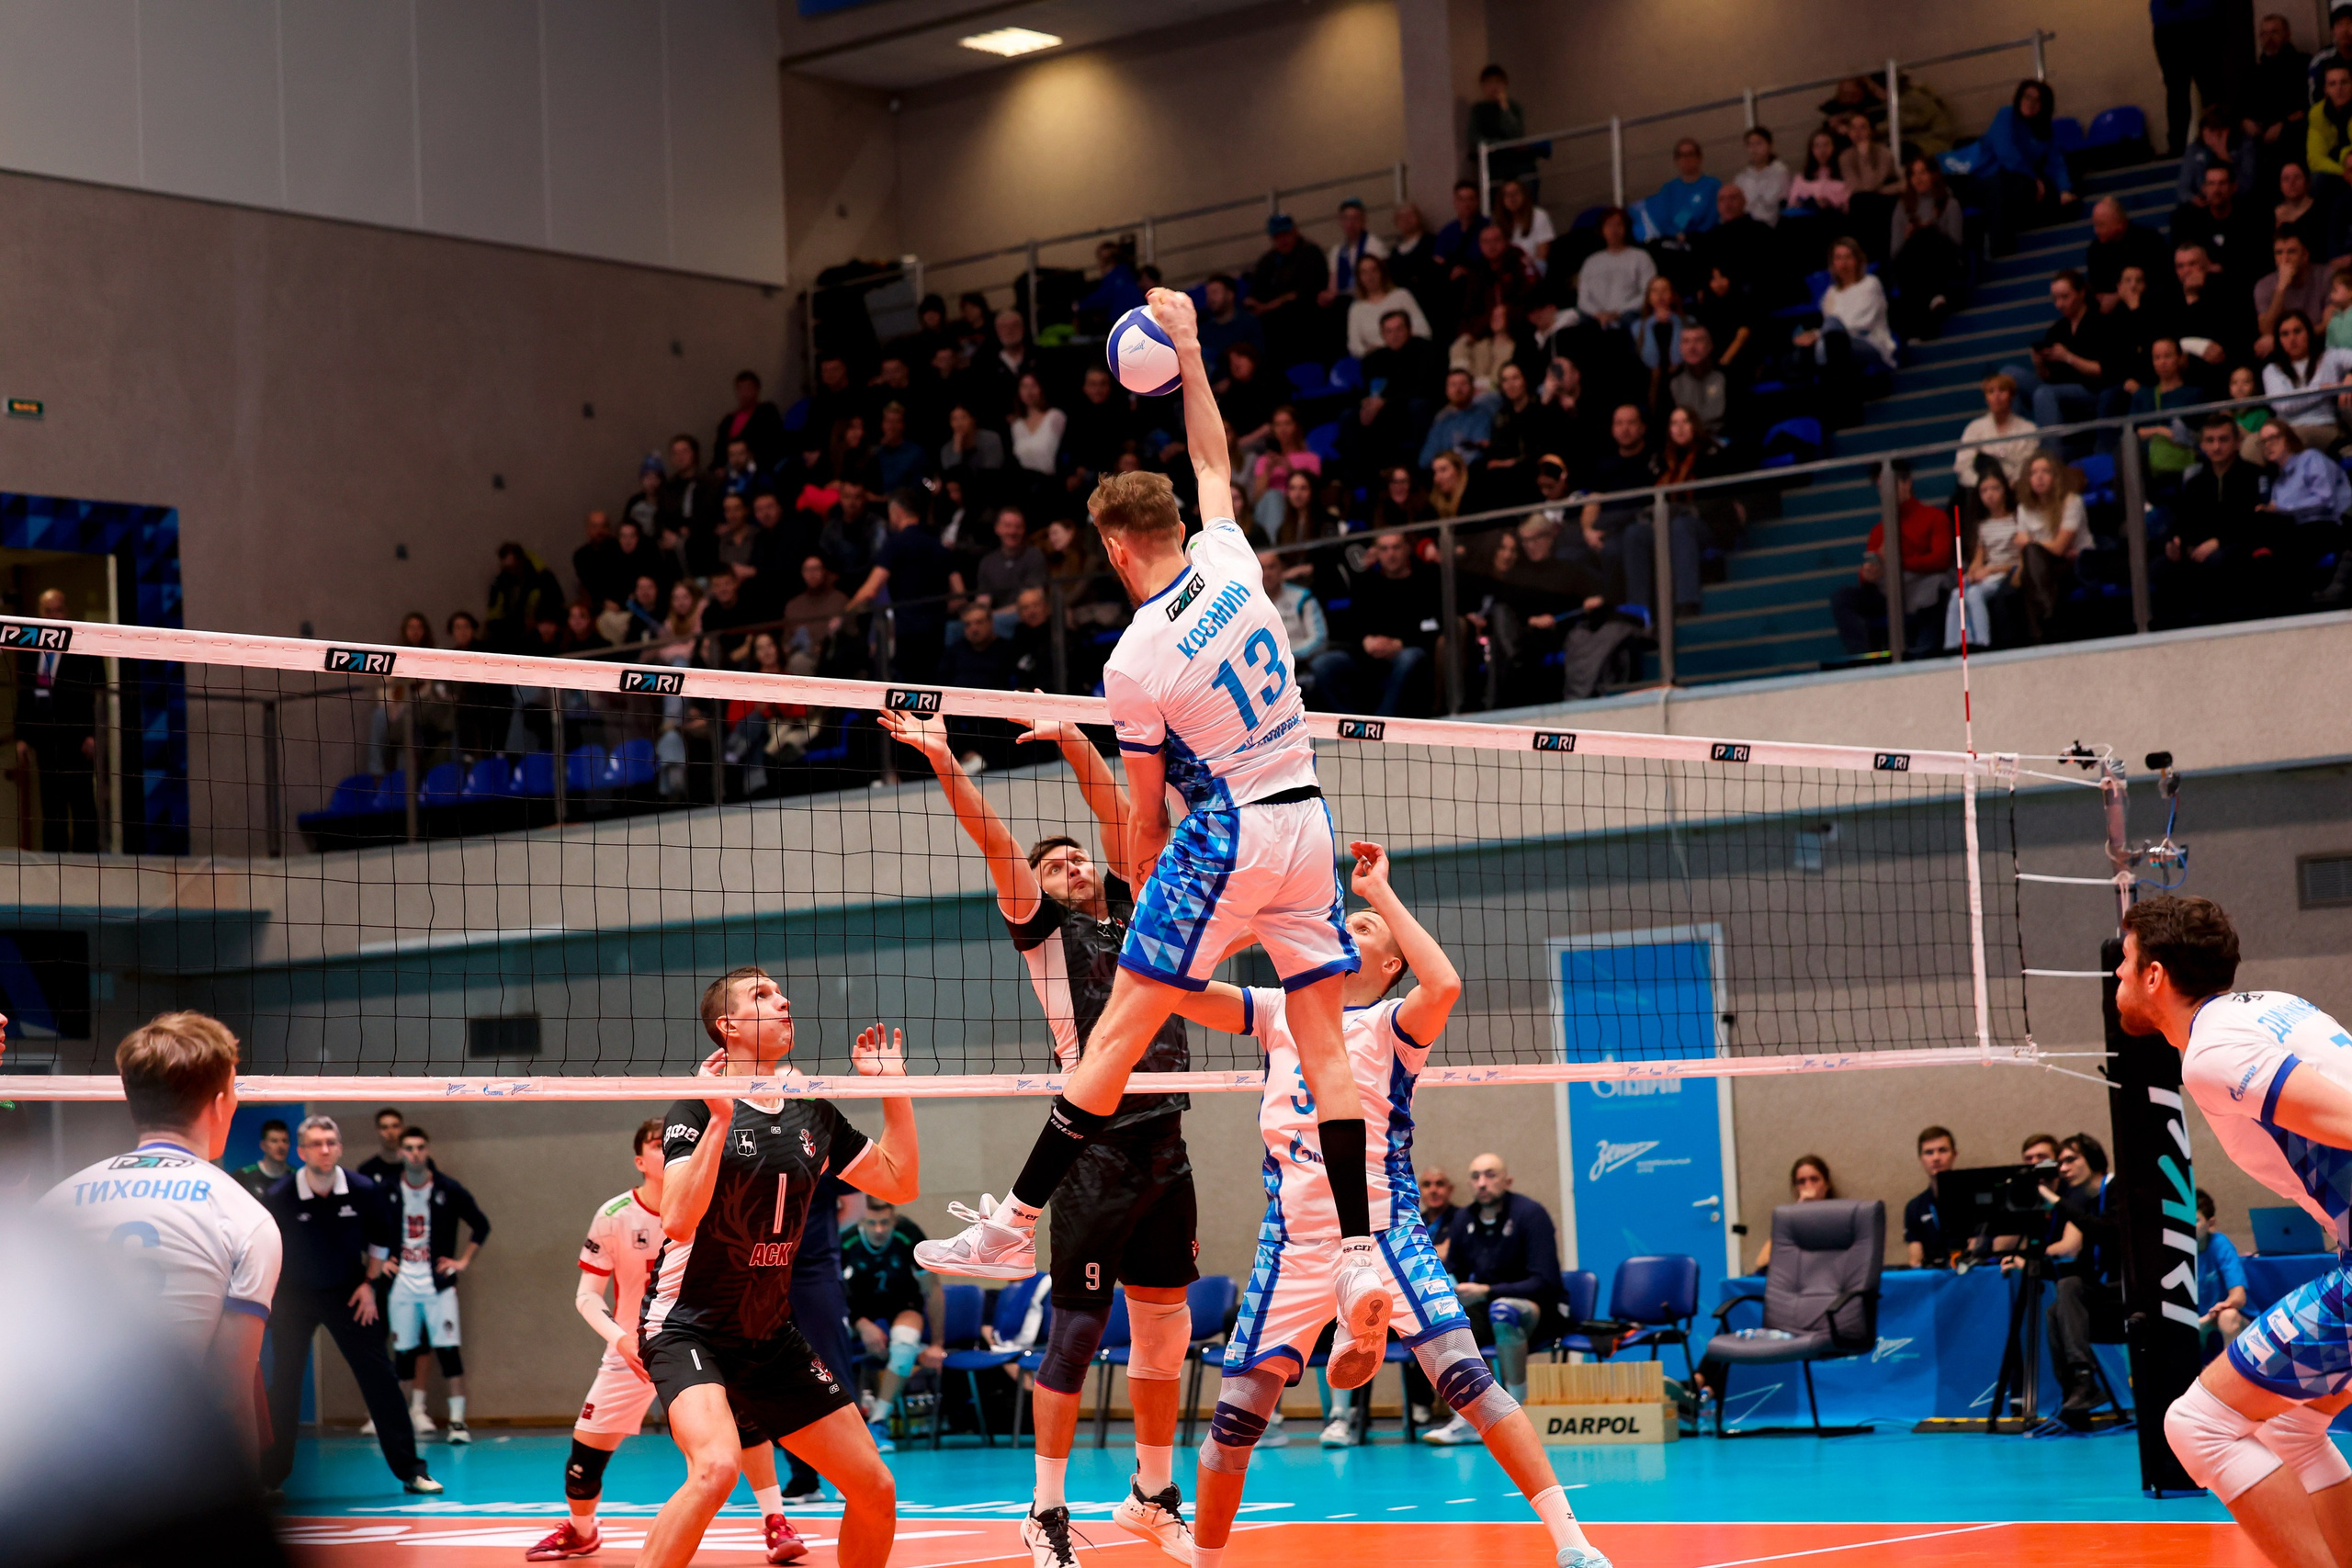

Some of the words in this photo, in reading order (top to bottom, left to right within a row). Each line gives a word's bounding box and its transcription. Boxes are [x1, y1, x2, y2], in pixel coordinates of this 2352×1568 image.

[1177, 581, 1251, 660] КОСМИН
[0, 625, 66, 649] PARI
[331, 651, 391, 673] PARI
[626, 671, 679, 693] PARI
[1211, 627, 1287, 732] 13
[890, 692, 938, 711] PARI
[1342, 721, 1382, 739] PARI
[1536, 735, 1573, 750] PARI
[1713, 745, 1747, 761] PARI
[1876, 754, 1908, 770] PARI
[74, 1179, 211, 1207] ТИХОНОВ
[773, 1173, 787, 1234] 1
[1085, 1262, 1101, 1291] 9
[690, 1348, 703, 1371] 1
[1547, 1416, 1641, 1436] DARPOL
